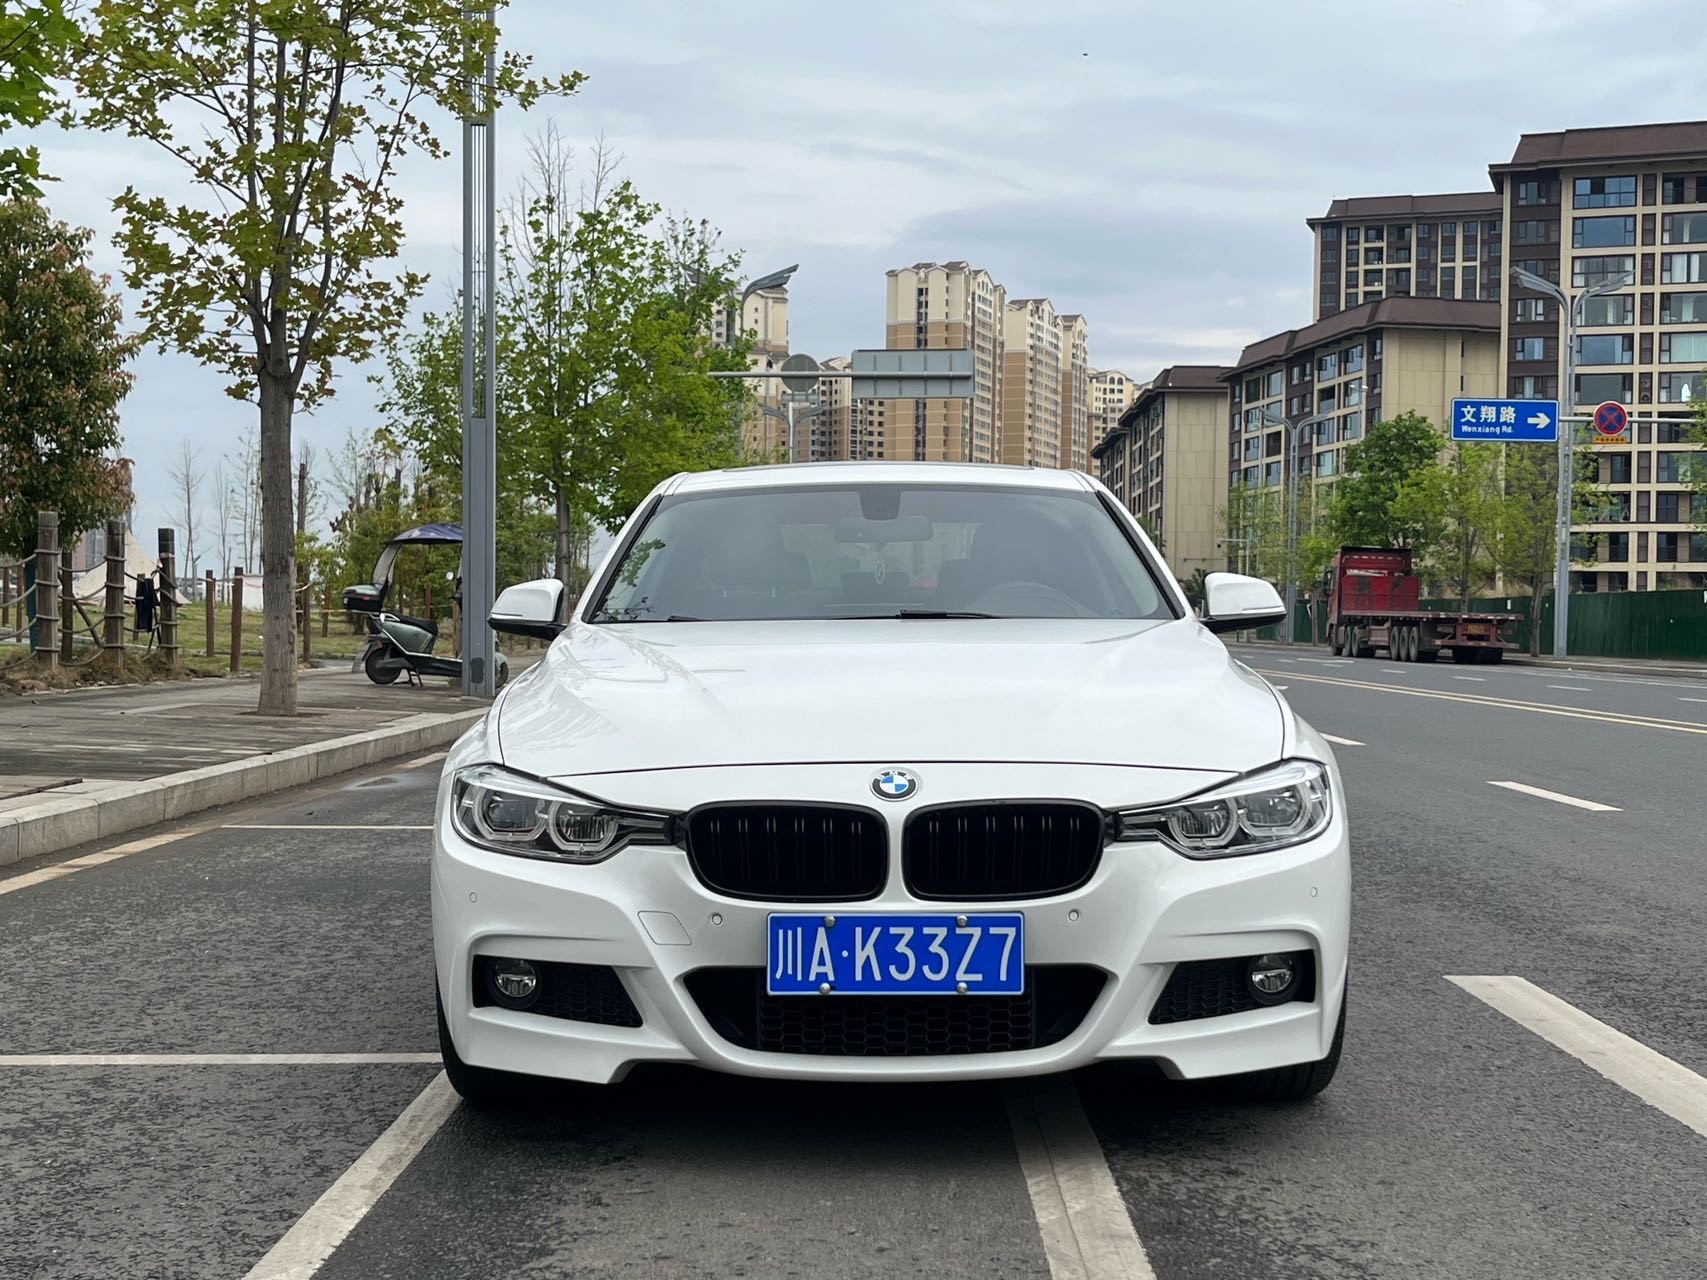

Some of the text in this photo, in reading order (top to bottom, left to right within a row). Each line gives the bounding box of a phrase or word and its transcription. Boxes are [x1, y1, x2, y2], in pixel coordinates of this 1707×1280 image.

[1460, 405, 1516, 423] 文翔路
[1461, 425, 1500, 435] Wenxiang
[775, 926, 1017, 982] 川A·K33Z7
